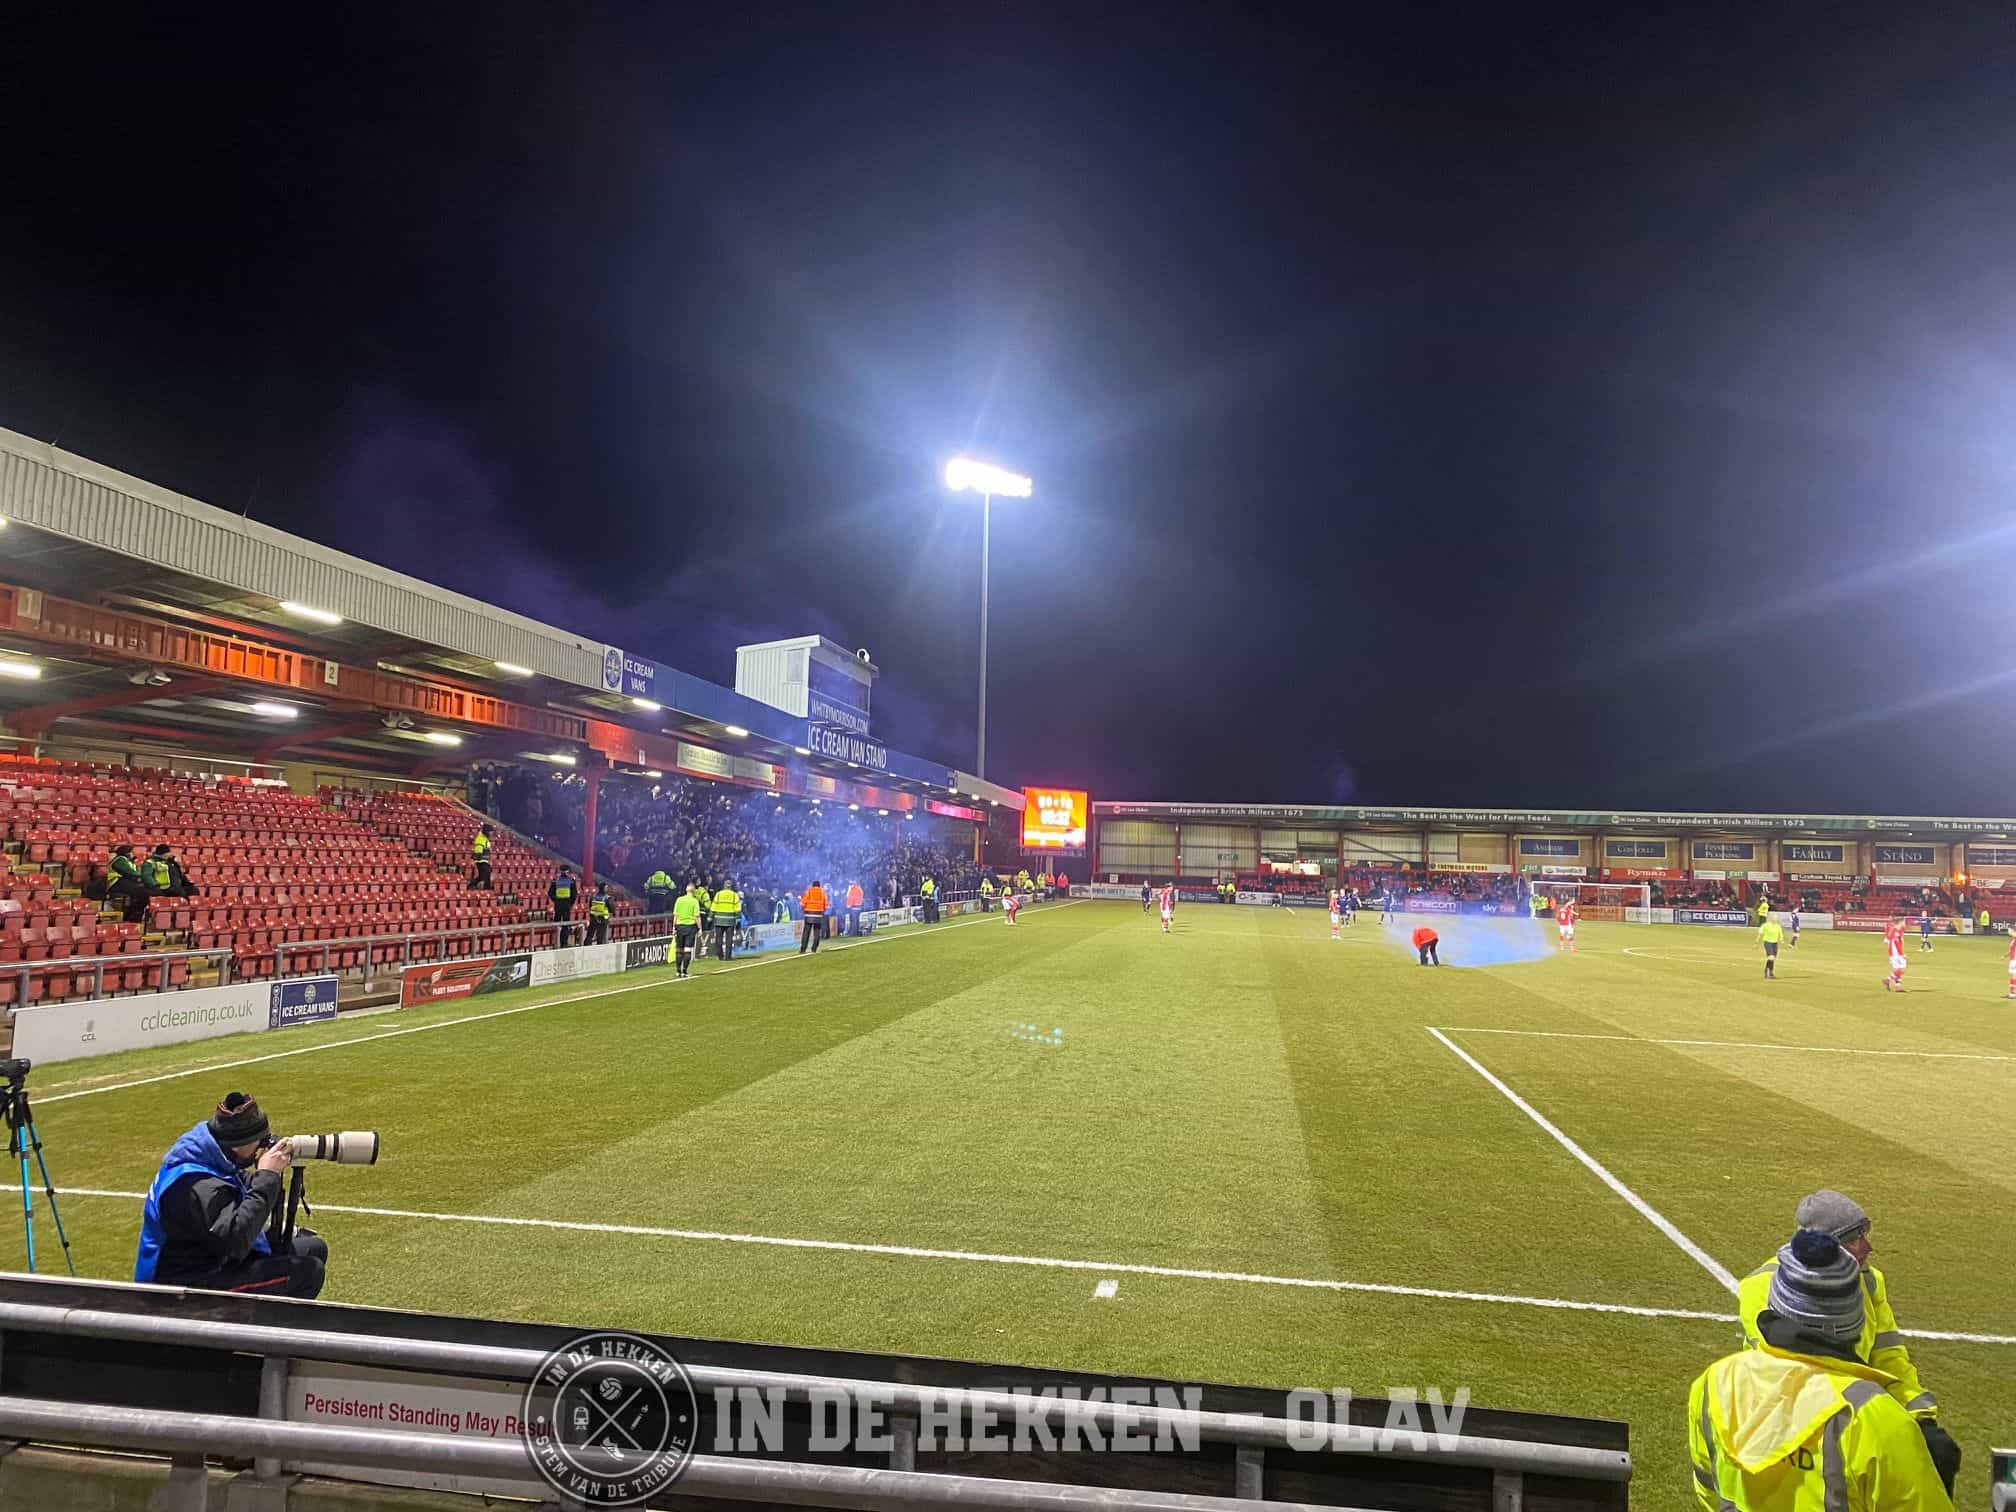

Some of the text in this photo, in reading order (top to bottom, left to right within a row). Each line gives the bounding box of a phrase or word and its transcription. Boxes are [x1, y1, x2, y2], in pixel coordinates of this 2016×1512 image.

[329, 664, 336, 680] 2
[624, 658, 654, 680] ICE CREAM
[630, 676, 646, 693] VANS
[807, 724, 887, 769] ICE CREAM VAN STAND
[1402, 812, 1417, 820] The
[1420, 812, 1437, 820] Best
[1440, 813, 1447, 821] in
[1450, 813, 1463, 821] the
[1489, 814, 1501, 822] for
[1657, 816, 1711, 826] Independent
[1713, 817, 1741, 826] British
[1744, 817, 1773, 826] Millers
[1934, 822, 1949, 830] The
[1952, 822, 1971, 830] Best
[1974, 822, 1983, 831] in
[1985, 822, 1999, 831] the
[1792, 847, 1833, 860] FAMILY
[1883, 849, 1923, 861] STAND
[1482, 903, 1497, 913] sky
[1692, 911, 1746, 922] ICE CREAM VANS
[645, 945, 664, 963] RADIO
[141, 999, 254, 1032] cclcleaning.co.uk
[282, 1001, 335, 1018] ICE CREAM VANS
[304, 1392, 557, 1440] Persistent Standing May Resul
